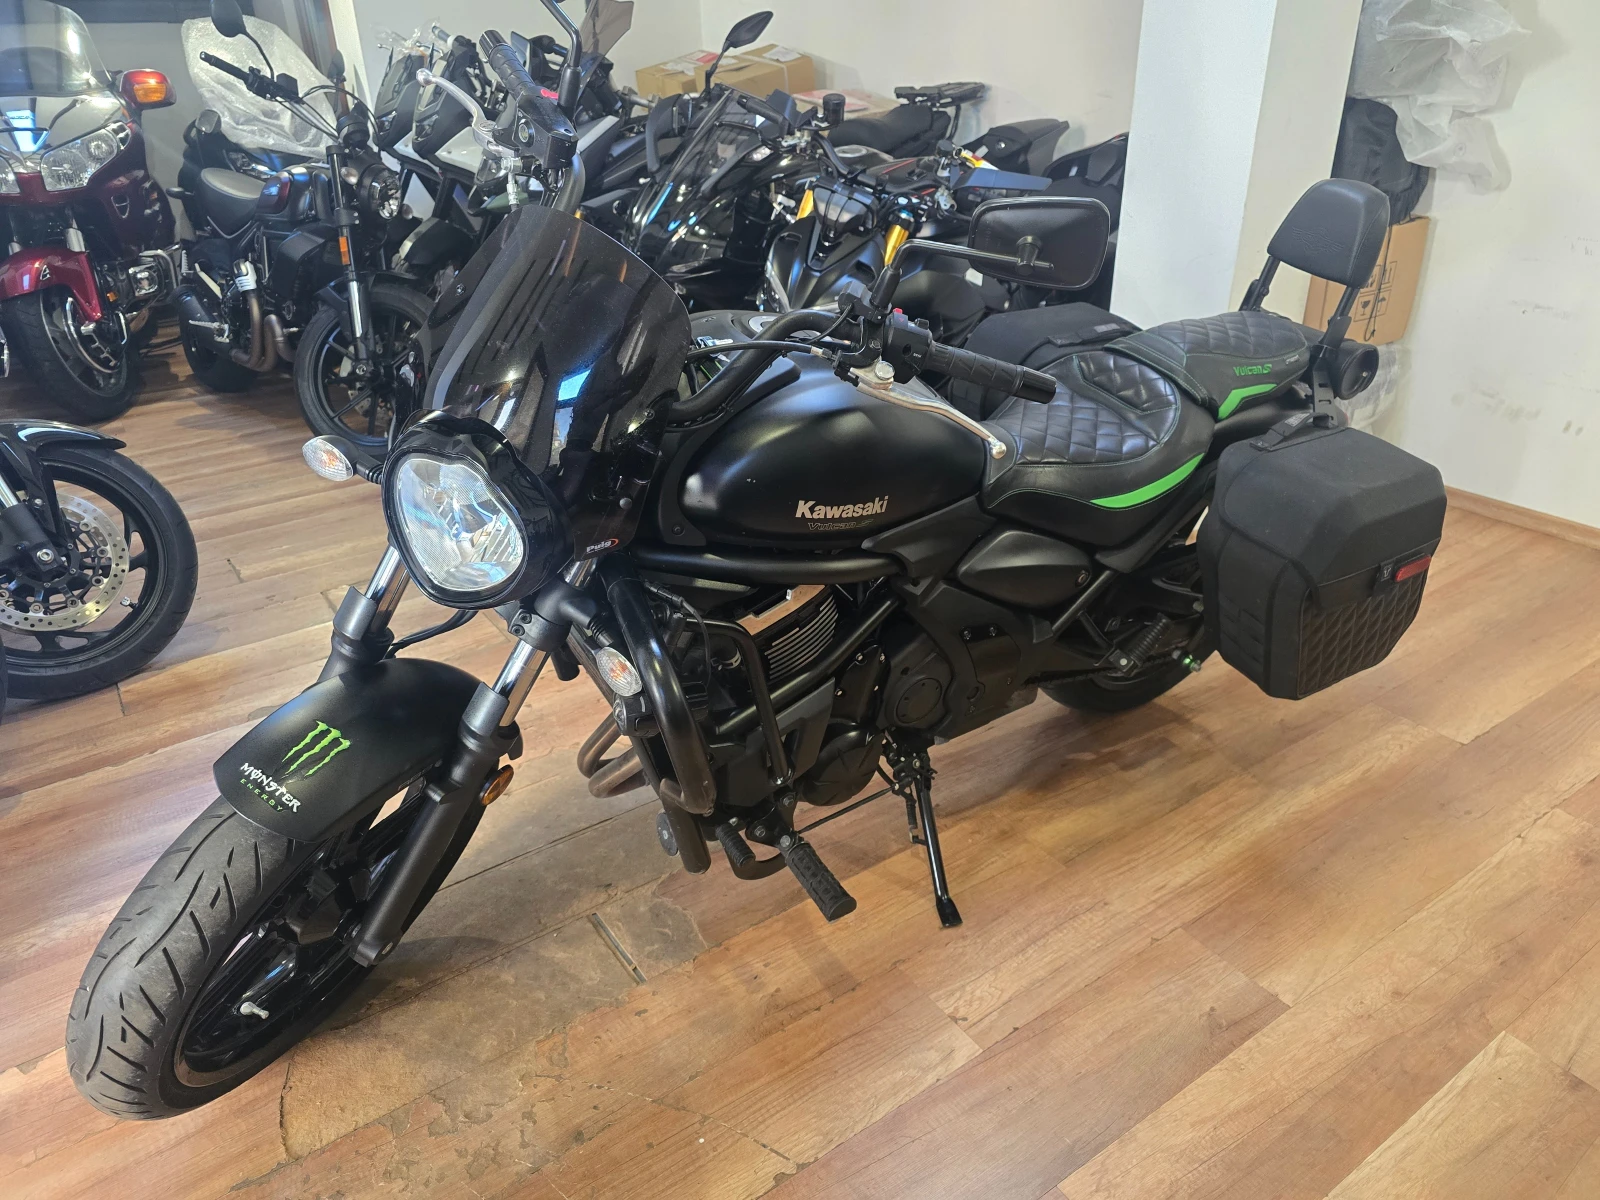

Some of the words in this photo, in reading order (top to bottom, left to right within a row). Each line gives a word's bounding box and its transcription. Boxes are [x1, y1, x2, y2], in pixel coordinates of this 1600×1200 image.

[795, 495, 889, 519] Kawasaki
[808, 521, 856, 531] Vulcan
[240, 778, 283, 811] ENERGY
